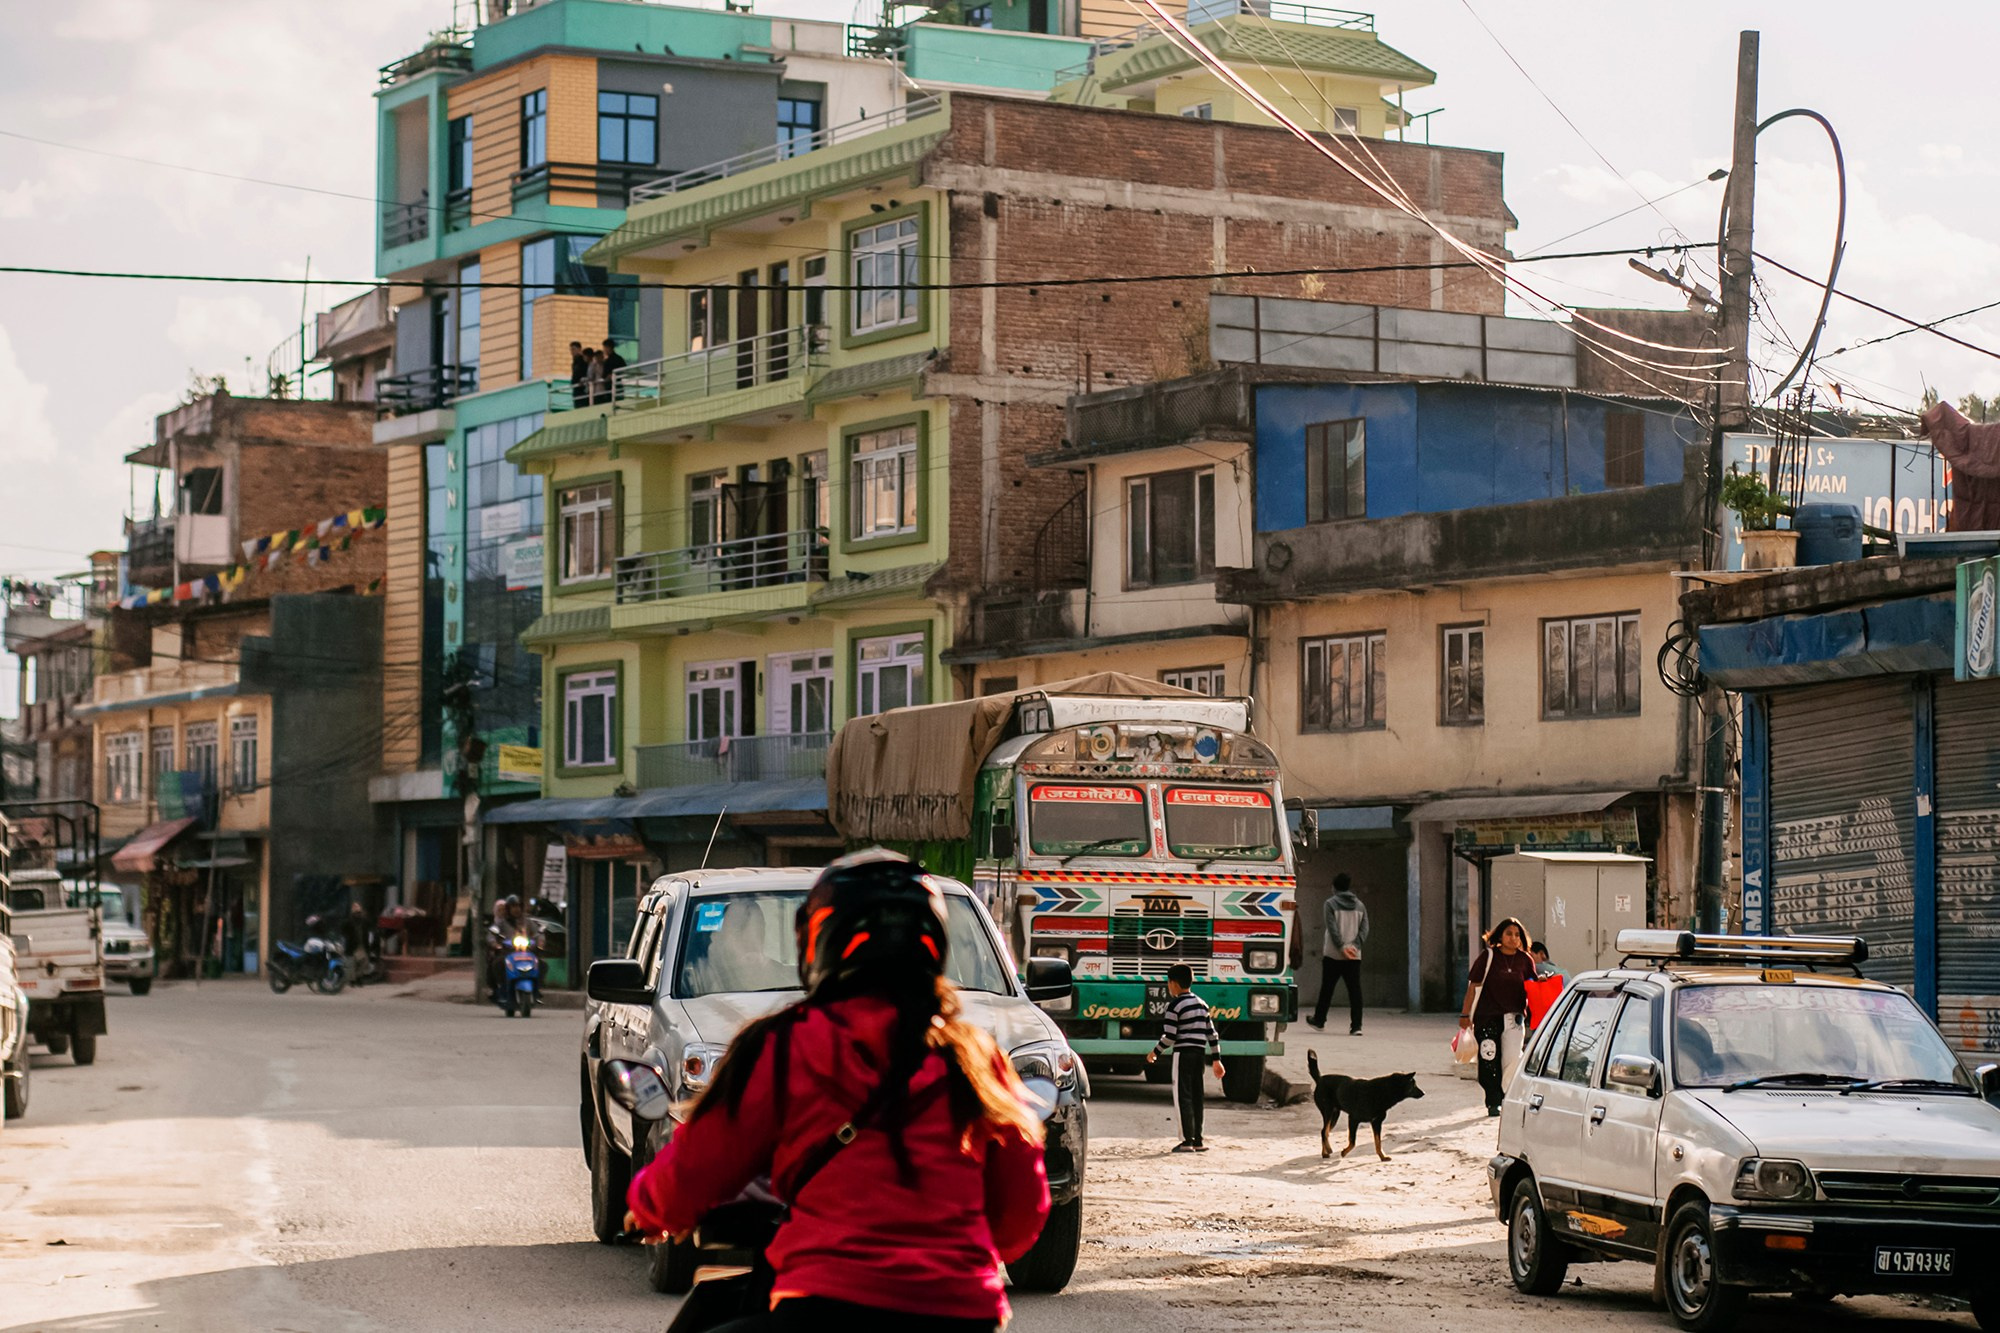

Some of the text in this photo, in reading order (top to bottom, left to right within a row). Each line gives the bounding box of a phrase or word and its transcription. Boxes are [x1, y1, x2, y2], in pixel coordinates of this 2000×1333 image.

[1047, 789, 1078, 799] जय
[1745, 788, 1763, 867] STEEL
[1142, 898, 1181, 913] TATA
[1768, 971, 1791, 981] TAXI
[1083, 1003, 1144, 1019] Speed
